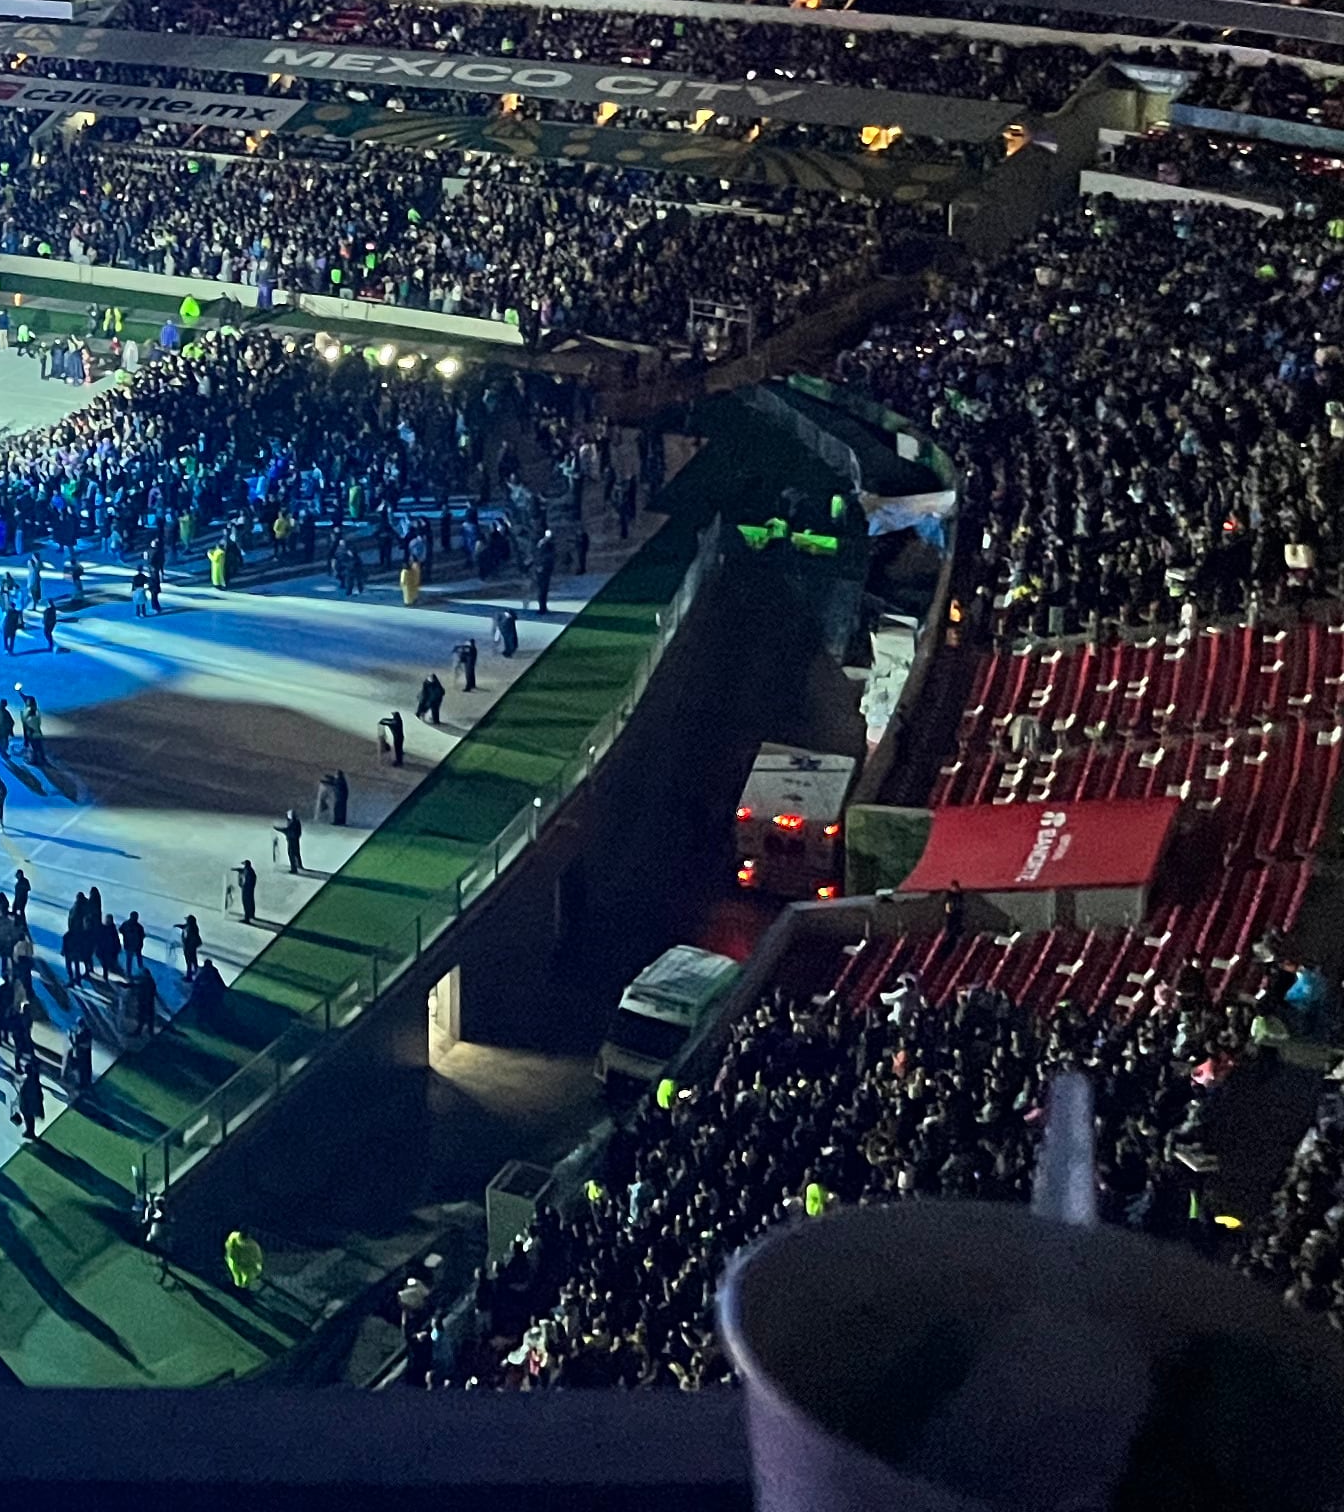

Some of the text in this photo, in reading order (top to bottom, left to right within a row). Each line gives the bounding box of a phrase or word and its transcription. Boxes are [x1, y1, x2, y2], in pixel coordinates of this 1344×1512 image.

[261, 46, 802, 106] MEXICO CITY
[21, 87, 282, 123] caliente.mx
